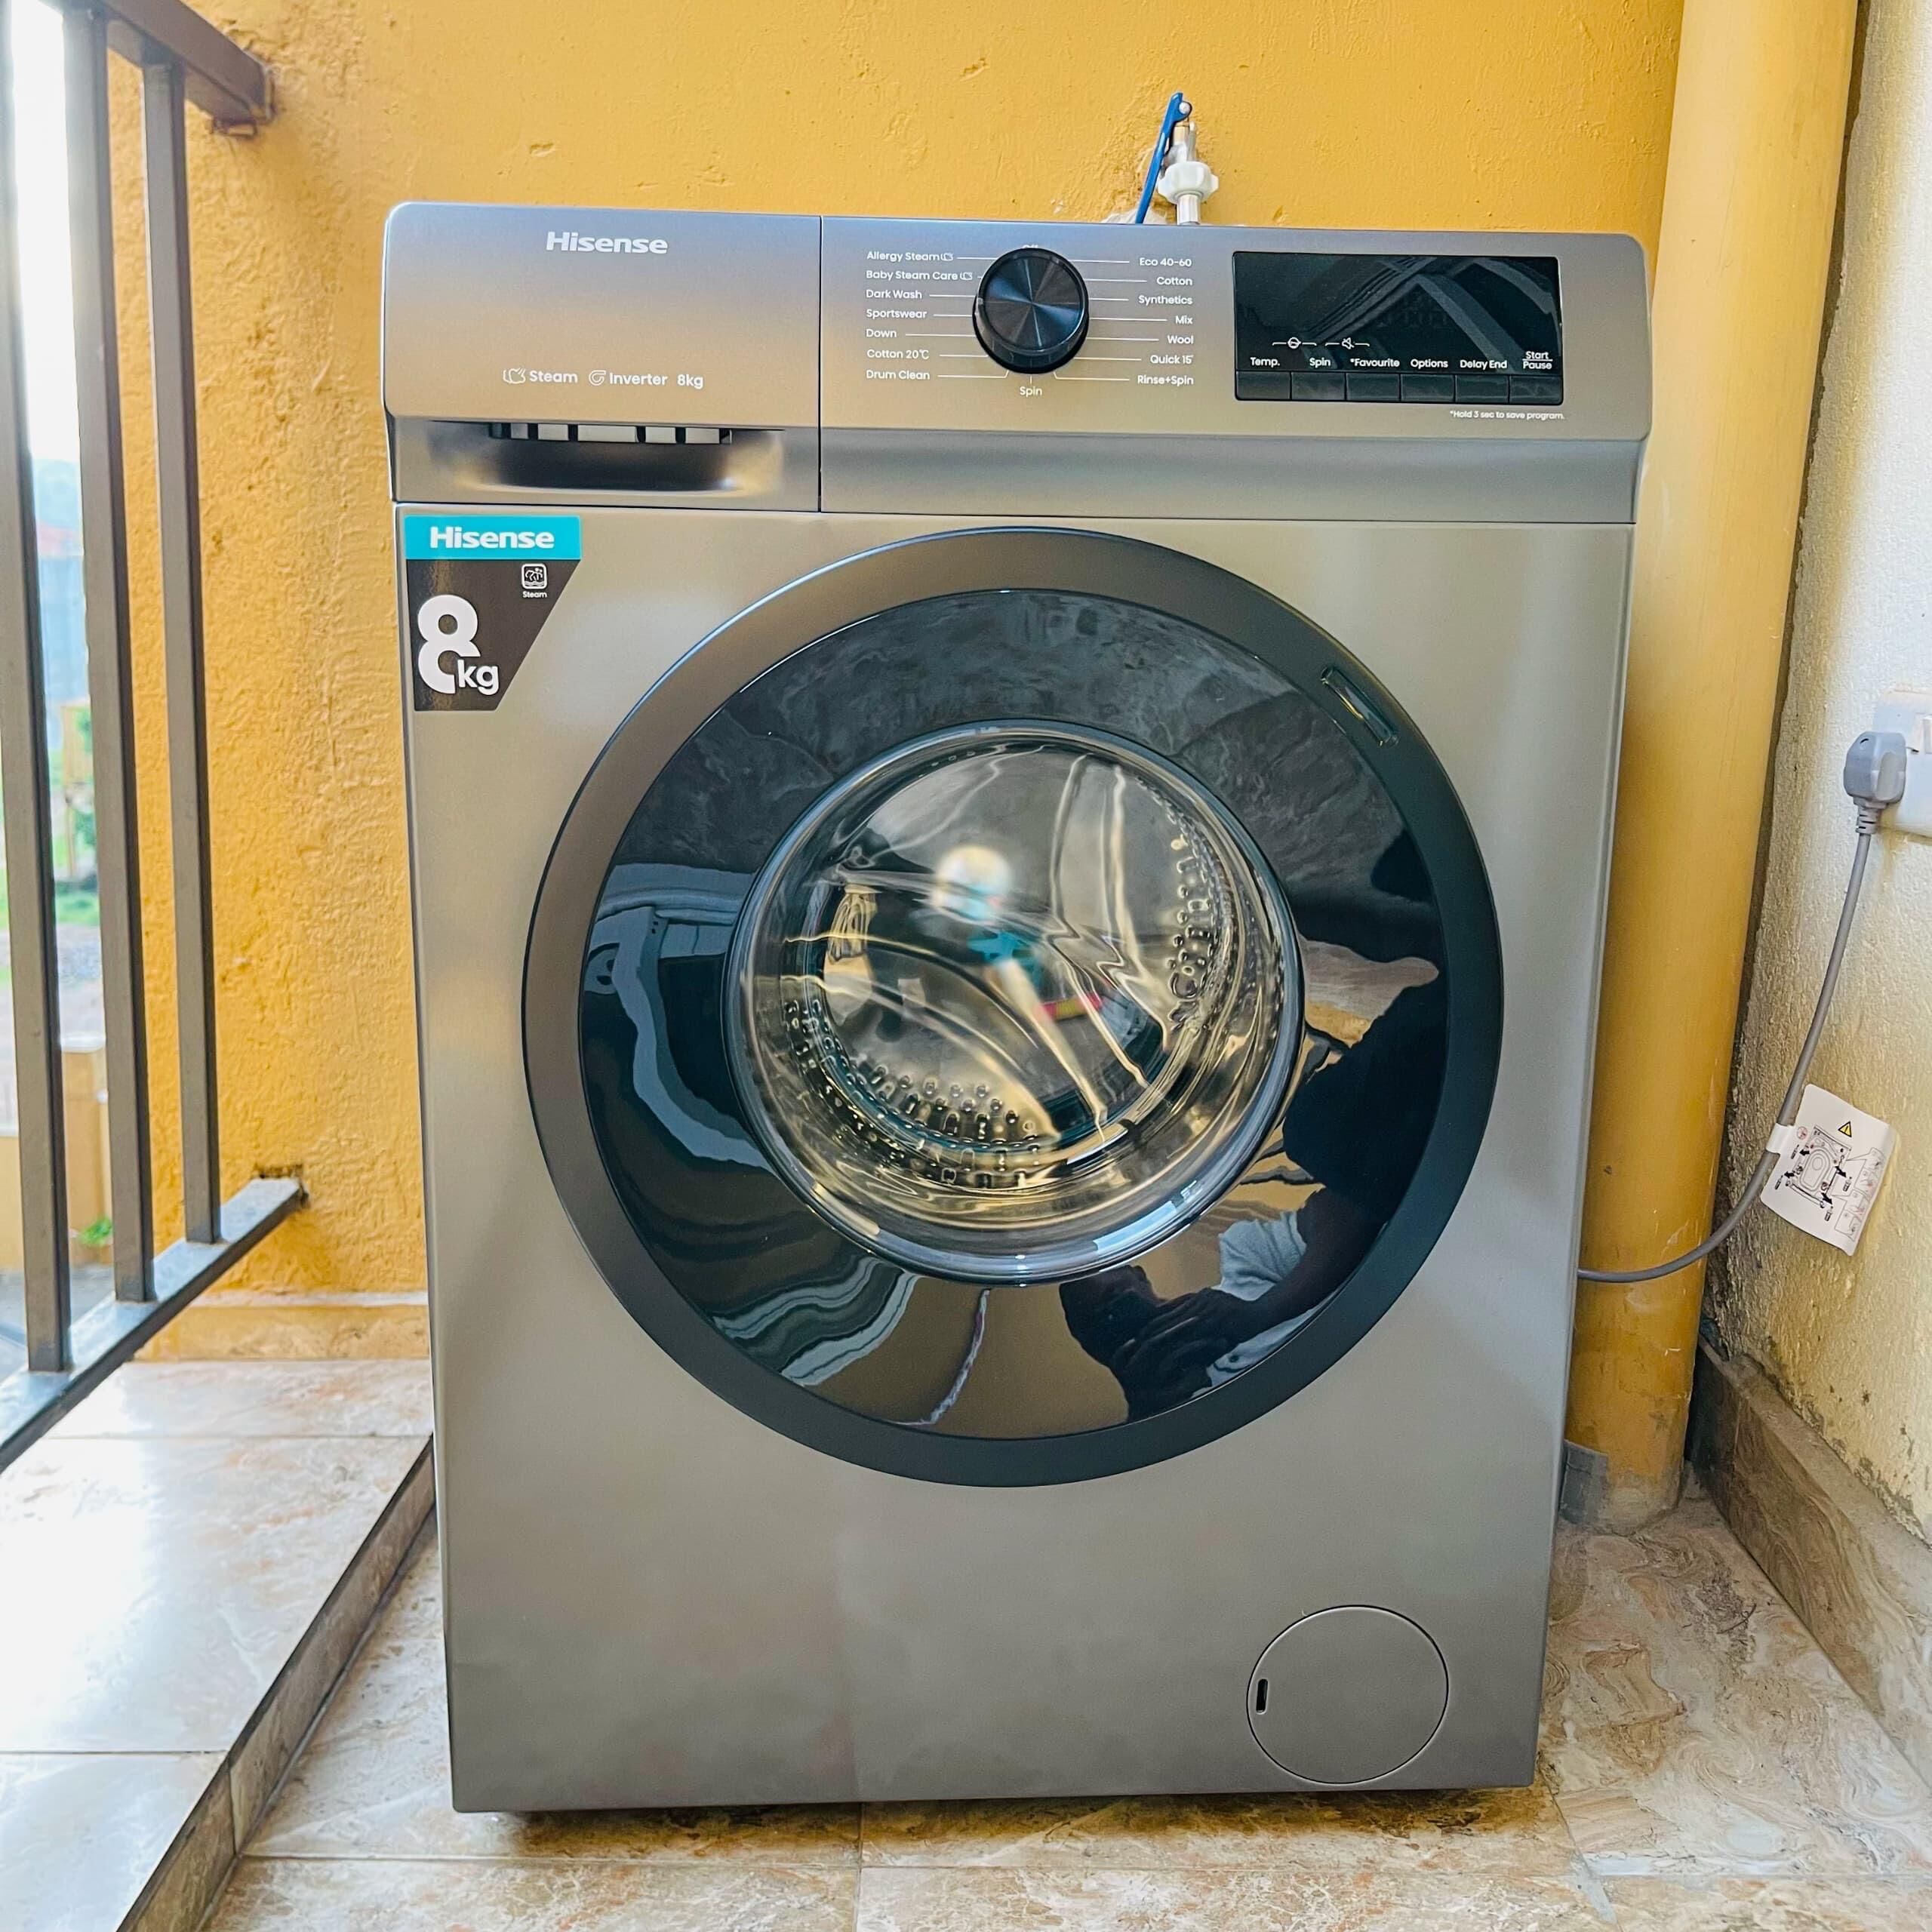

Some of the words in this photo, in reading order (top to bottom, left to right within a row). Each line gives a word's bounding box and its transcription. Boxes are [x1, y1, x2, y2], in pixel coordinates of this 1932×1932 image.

[546, 231, 669, 254] Hisense
[866, 251, 903, 262] Allergy
[905, 252, 940, 261] Steam
[1139, 257, 1158, 266] Eco
[1160, 257, 1192, 266] 40-60
[866, 270, 894, 281] Baby
[895, 270, 931, 280] Steam
[932, 271, 958, 281] Care
[1156, 276, 1192, 285] Cotton
[866, 289, 891, 298] Dark
[893, 290, 922, 299] Wash
[1138, 295, 1193, 306] Synthetics
[866, 308, 928, 319] Sportswear
[1175, 315, 1193, 325] Mix
[866, 328, 897, 338] Down
[1167, 335, 1194, 344] Wool
[866, 349, 903, 358] Cotton
[1149, 354, 1180, 364] Quick
[1525, 351, 1549, 359] Start
[1250, 356, 1281, 368] Temp.
[1309, 357, 1331, 368] Spin
[1410, 358, 1449, 369] Options
[1460, 359, 1488, 371] Delay
[1489, 359, 1508, 369] End
[1522, 361, 1552, 370] Pause
[529, 371, 578, 383] Steam
[609, 372, 669, 386] Inverter
[866, 369, 897, 379] Drum
[898, 370, 930, 380] Clean
[1137, 374, 1194, 386] Rinse+Spin
[677, 373, 703, 389] 8kg
[1020, 386, 1043, 397] Spin
[1496, 411, 1505, 419] to
[1526, 412, 1565, 421] program.
[429, 526, 555, 549] Hisense
[521, 590, 548, 599] Steam
